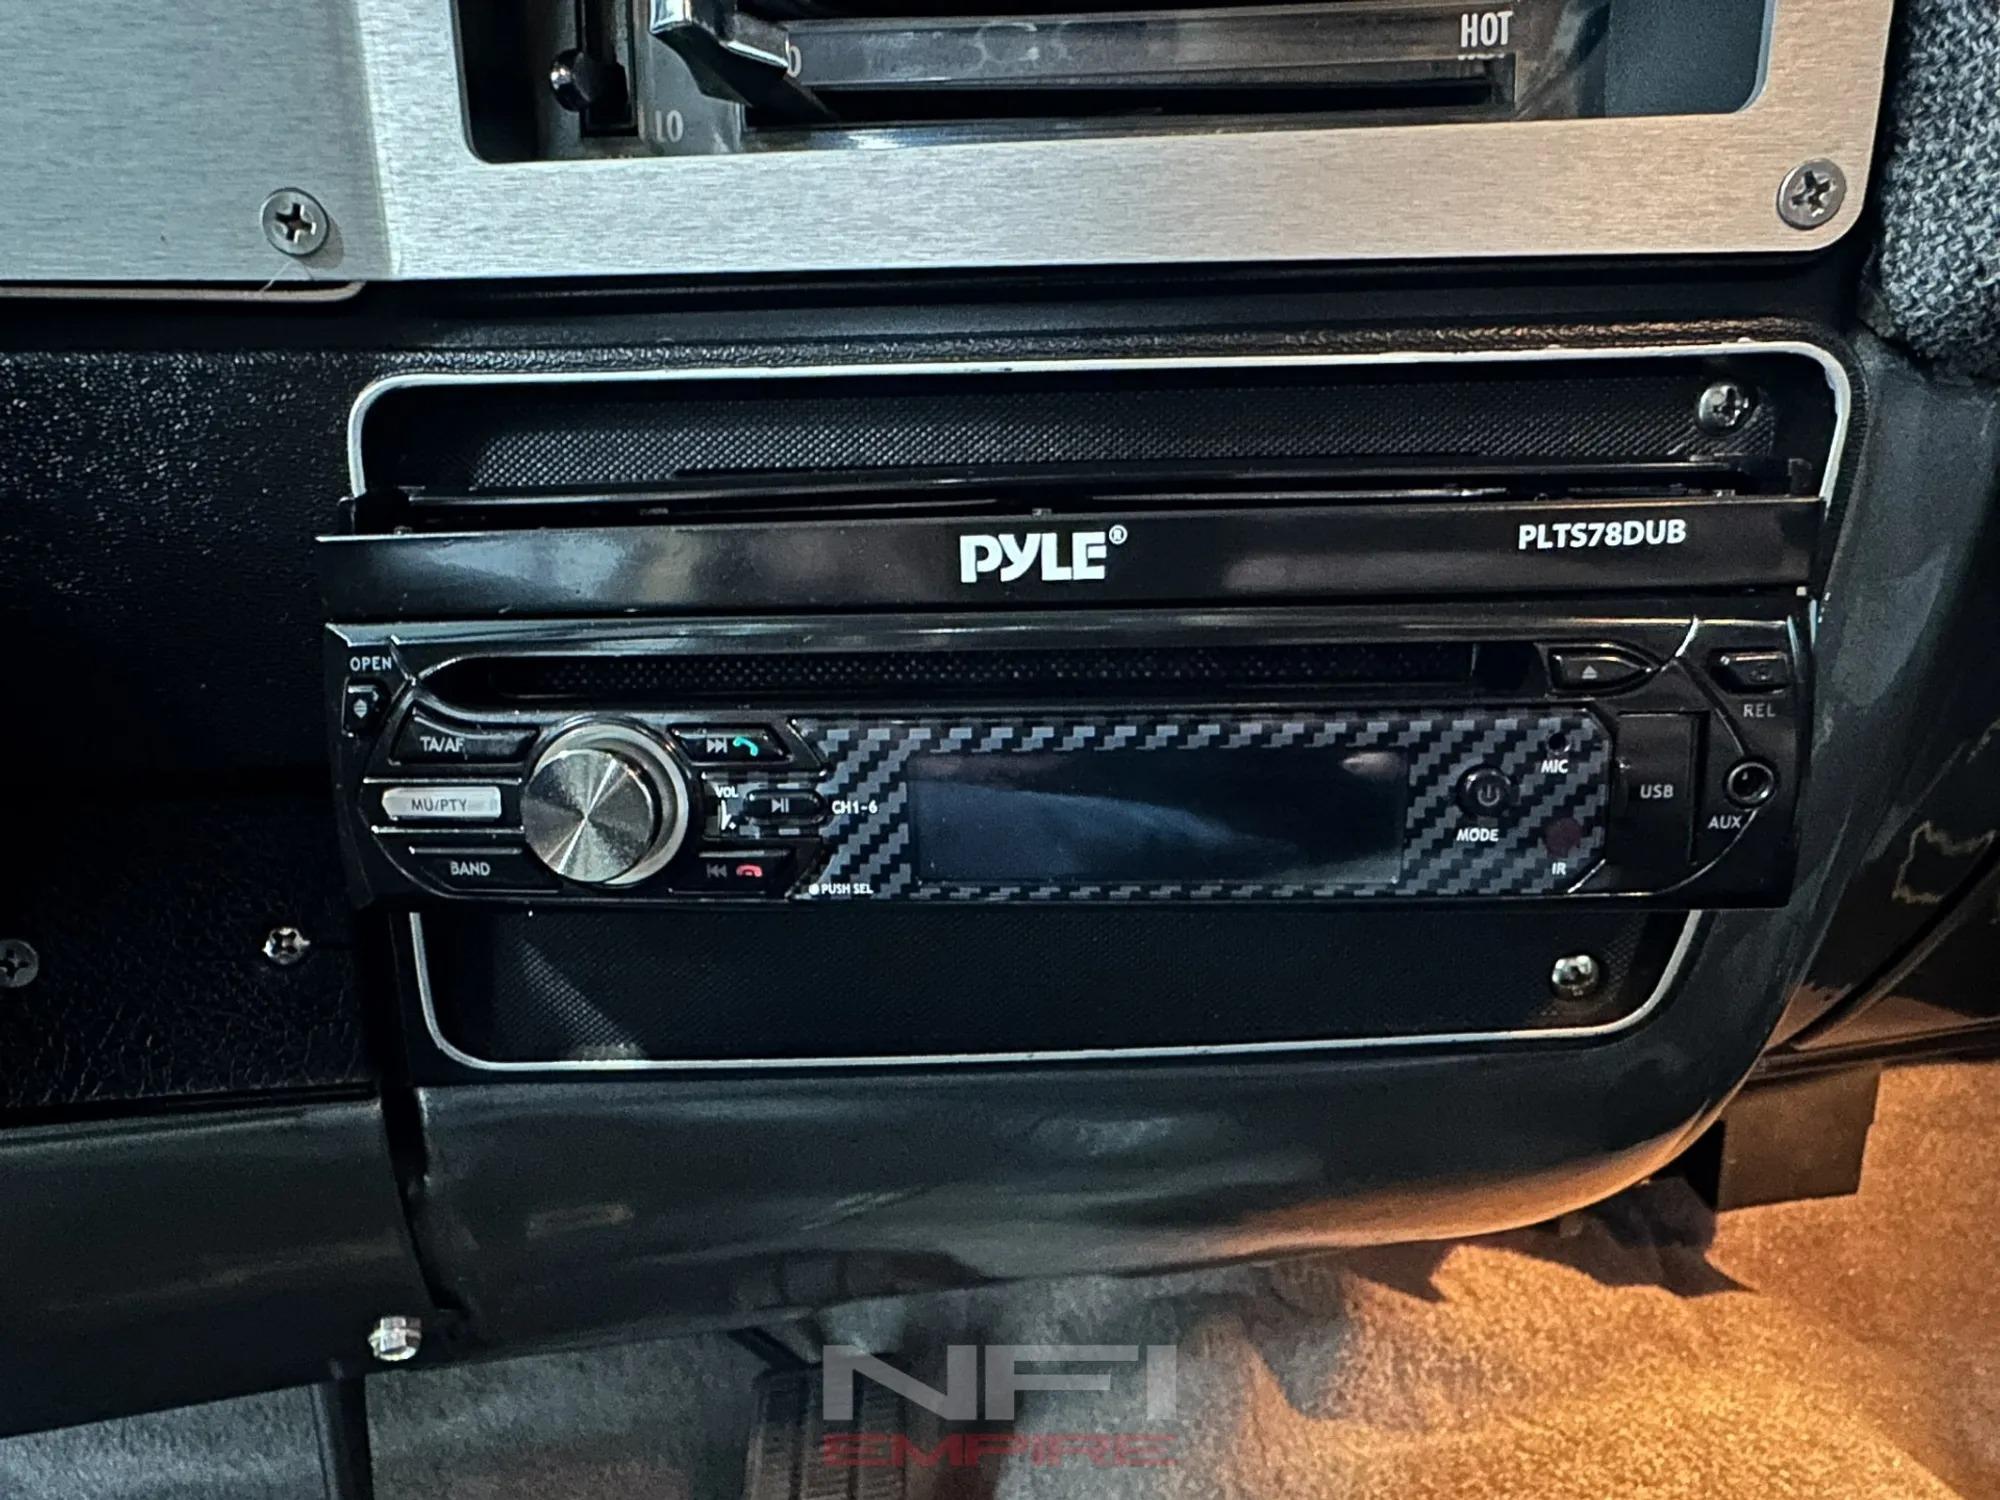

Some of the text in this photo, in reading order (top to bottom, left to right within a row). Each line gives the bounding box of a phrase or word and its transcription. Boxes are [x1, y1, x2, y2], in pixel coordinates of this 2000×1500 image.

[1459, 10, 1514, 48] HOT
[1518, 519, 1687, 550] PLTS78DUB
[350, 655, 393, 672] OPEN
[1743, 702, 1777, 718] REL
[419, 735, 466, 753] TA/AF
[1540, 758, 1569, 775] MIC
[714, 785, 739, 799] VOL
[1639, 783, 1675, 800] USB
[411, 797, 468, 812] MU/PTY
[831, 799, 879, 815] CH1-6
[1707, 815, 1742, 830] AUX
[1456, 827, 1500, 843] MODE
[449, 860, 491, 877] BAND
[1551, 861, 1567, 877] IR
[821, 882, 874, 896] PUSH SEL
